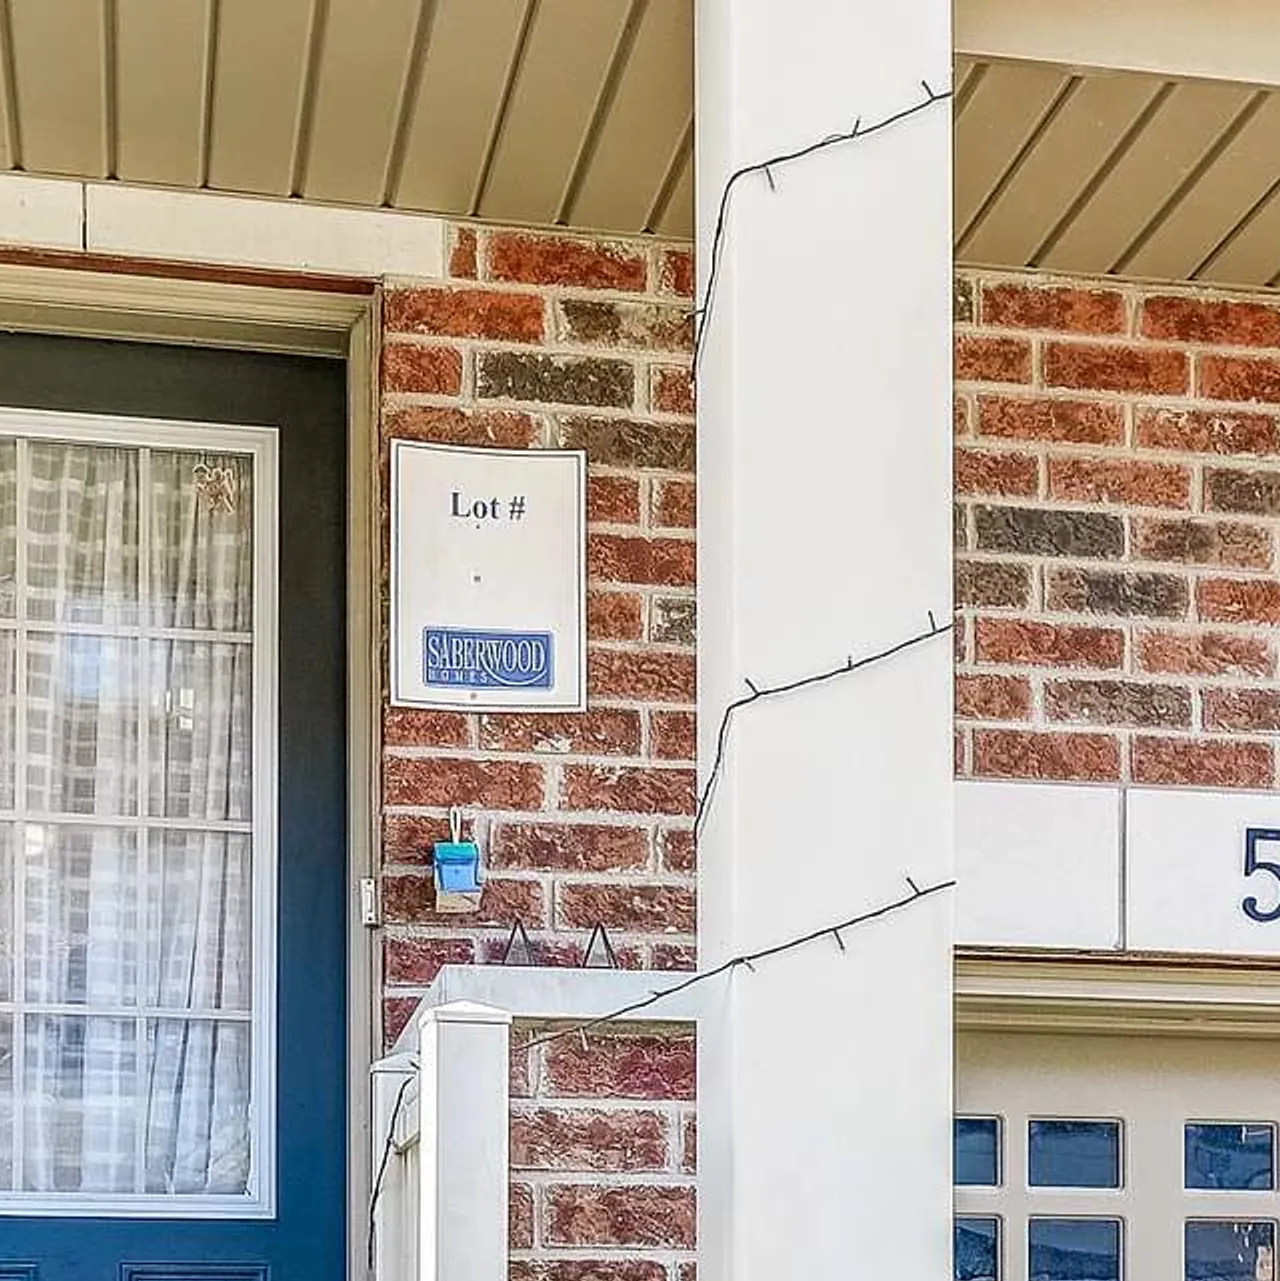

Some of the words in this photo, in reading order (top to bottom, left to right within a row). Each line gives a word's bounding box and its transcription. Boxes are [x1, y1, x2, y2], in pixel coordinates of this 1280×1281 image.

[451, 491, 500, 519] Lot
[508, 495, 526, 521] #
[428, 634, 546, 672] SABERWOOD
